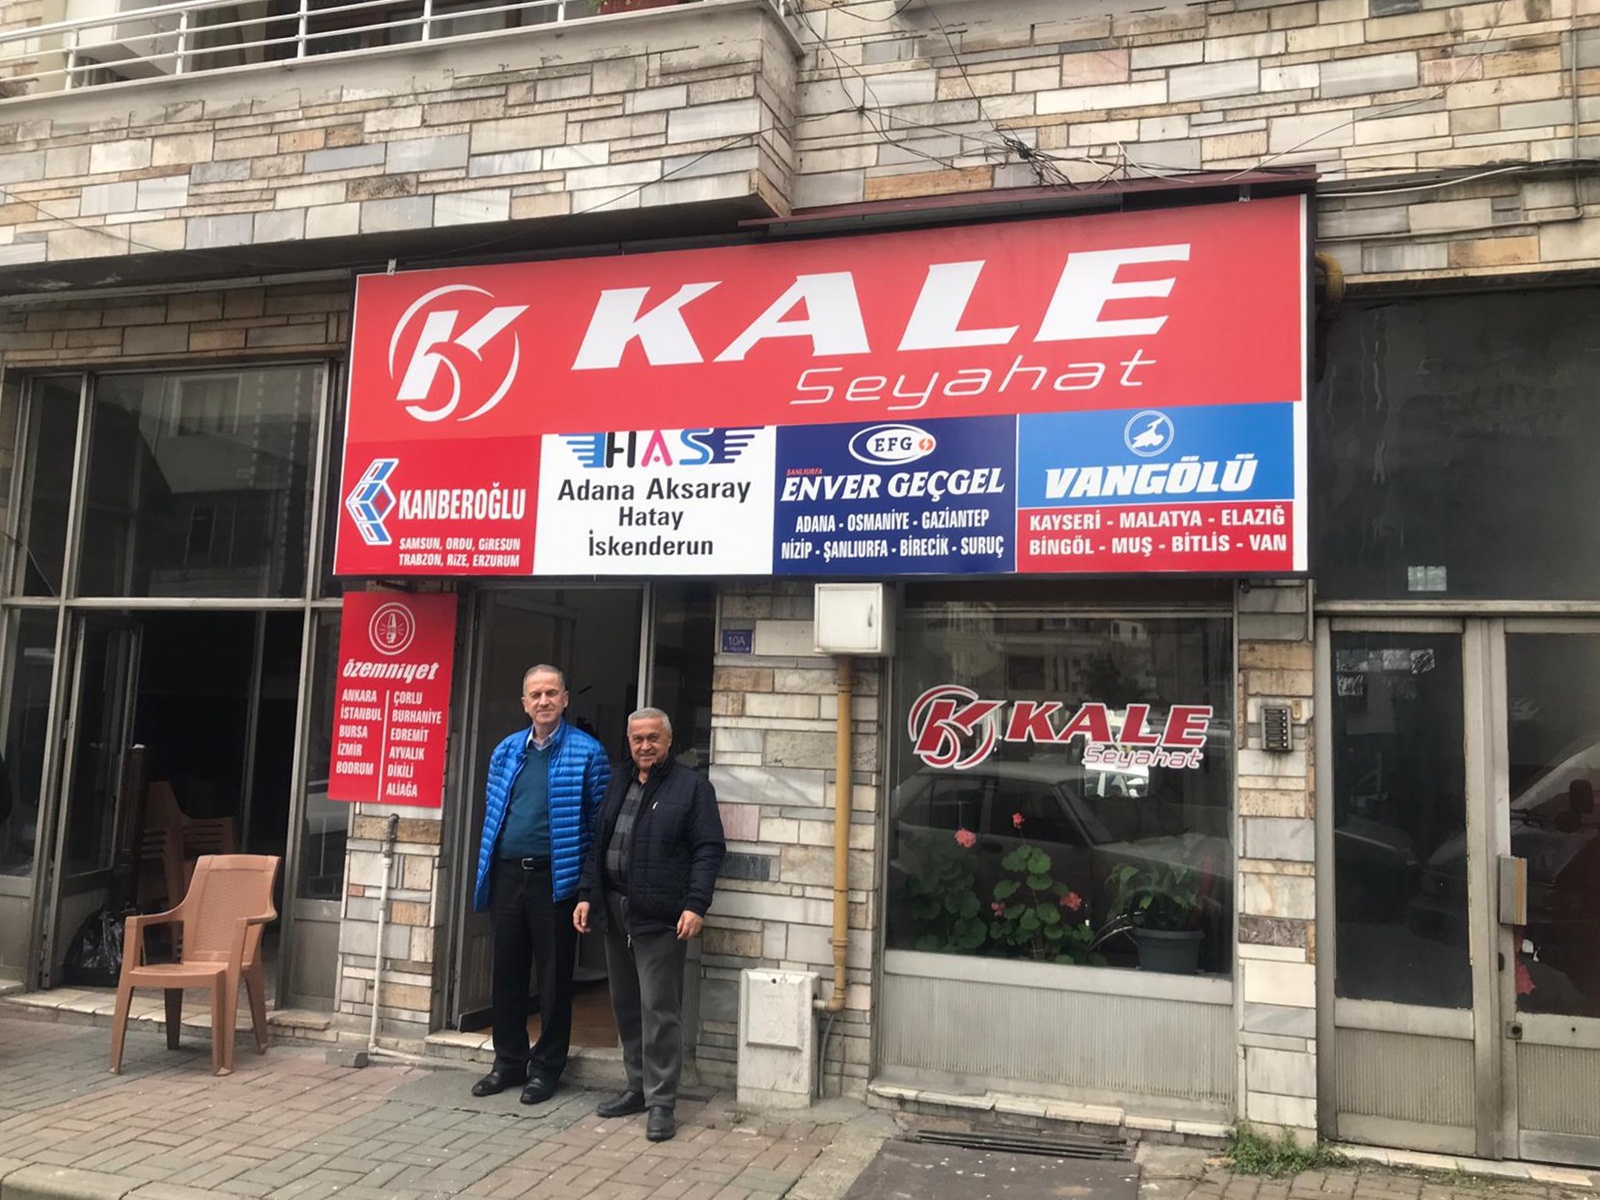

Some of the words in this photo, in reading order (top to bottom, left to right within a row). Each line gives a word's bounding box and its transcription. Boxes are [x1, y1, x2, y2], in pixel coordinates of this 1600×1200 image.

[571, 244, 1191, 370] KALE
[790, 349, 1156, 410] Seyahat
[605, 427, 712, 468] HAS
[873, 436, 913, 453] EFG
[780, 474, 882, 501] ENVER
[887, 467, 1006, 502] GEÇGEL
[1045, 453, 1258, 499] VANGÖLÜ
[398, 481, 526, 520] KANBEROĞLU
[557, 479, 634, 501] Adana
[646, 477, 751, 503] Aksaray
[618, 506, 684, 530] Hatay
[795, 515, 836, 533] ADANA
[847, 508, 910, 531] OSMANİYE
[921, 507, 990, 530] GAZİANTEP
[1030, 510, 1101, 531] KAYSERİ
[1119, 510, 1202, 529] MALATYA
[1221, 505, 1285, 526] ELAZIĞ
[399, 537, 442, 551] SAMSUN,
[445, 538, 475, 552] ORDU,
[588, 529, 714, 556] İskenderun
[781, 538, 813, 560] NİZİP
[823, 542, 888, 562] ŞANLIURFA
[900, 535, 949, 557] BİRECİK
[960, 535, 1005, 558] SURUÇ
[1029, 534, 1095, 556] BİNGÖL
[1111, 536, 1153, 557] MUŞ
[1171, 531, 1230, 552] BİTLİS
[1249, 534, 1287, 551] VAN
[398, 553, 444, 567] TRABZON,
[472, 554, 520, 567] ERZURUM
[341, 688, 377, 703] ANKARA
[393, 691, 423, 707] ÇORLU
[340, 703, 382, 721] İSTANBUL
[391, 708, 442, 725] BURHANİYE
[1004, 700, 1214, 748] KALE
[338, 725, 368, 738] BURSA
[390, 727, 430, 743] EDREMİT
[337, 742, 363, 756] İZMİR
[388, 746, 425, 761] AYVALIK
[1081, 742, 1205, 769] Seyahat
[335, 761, 374, 776] BODRUM
[387, 762, 414, 779] DİKİLİ
